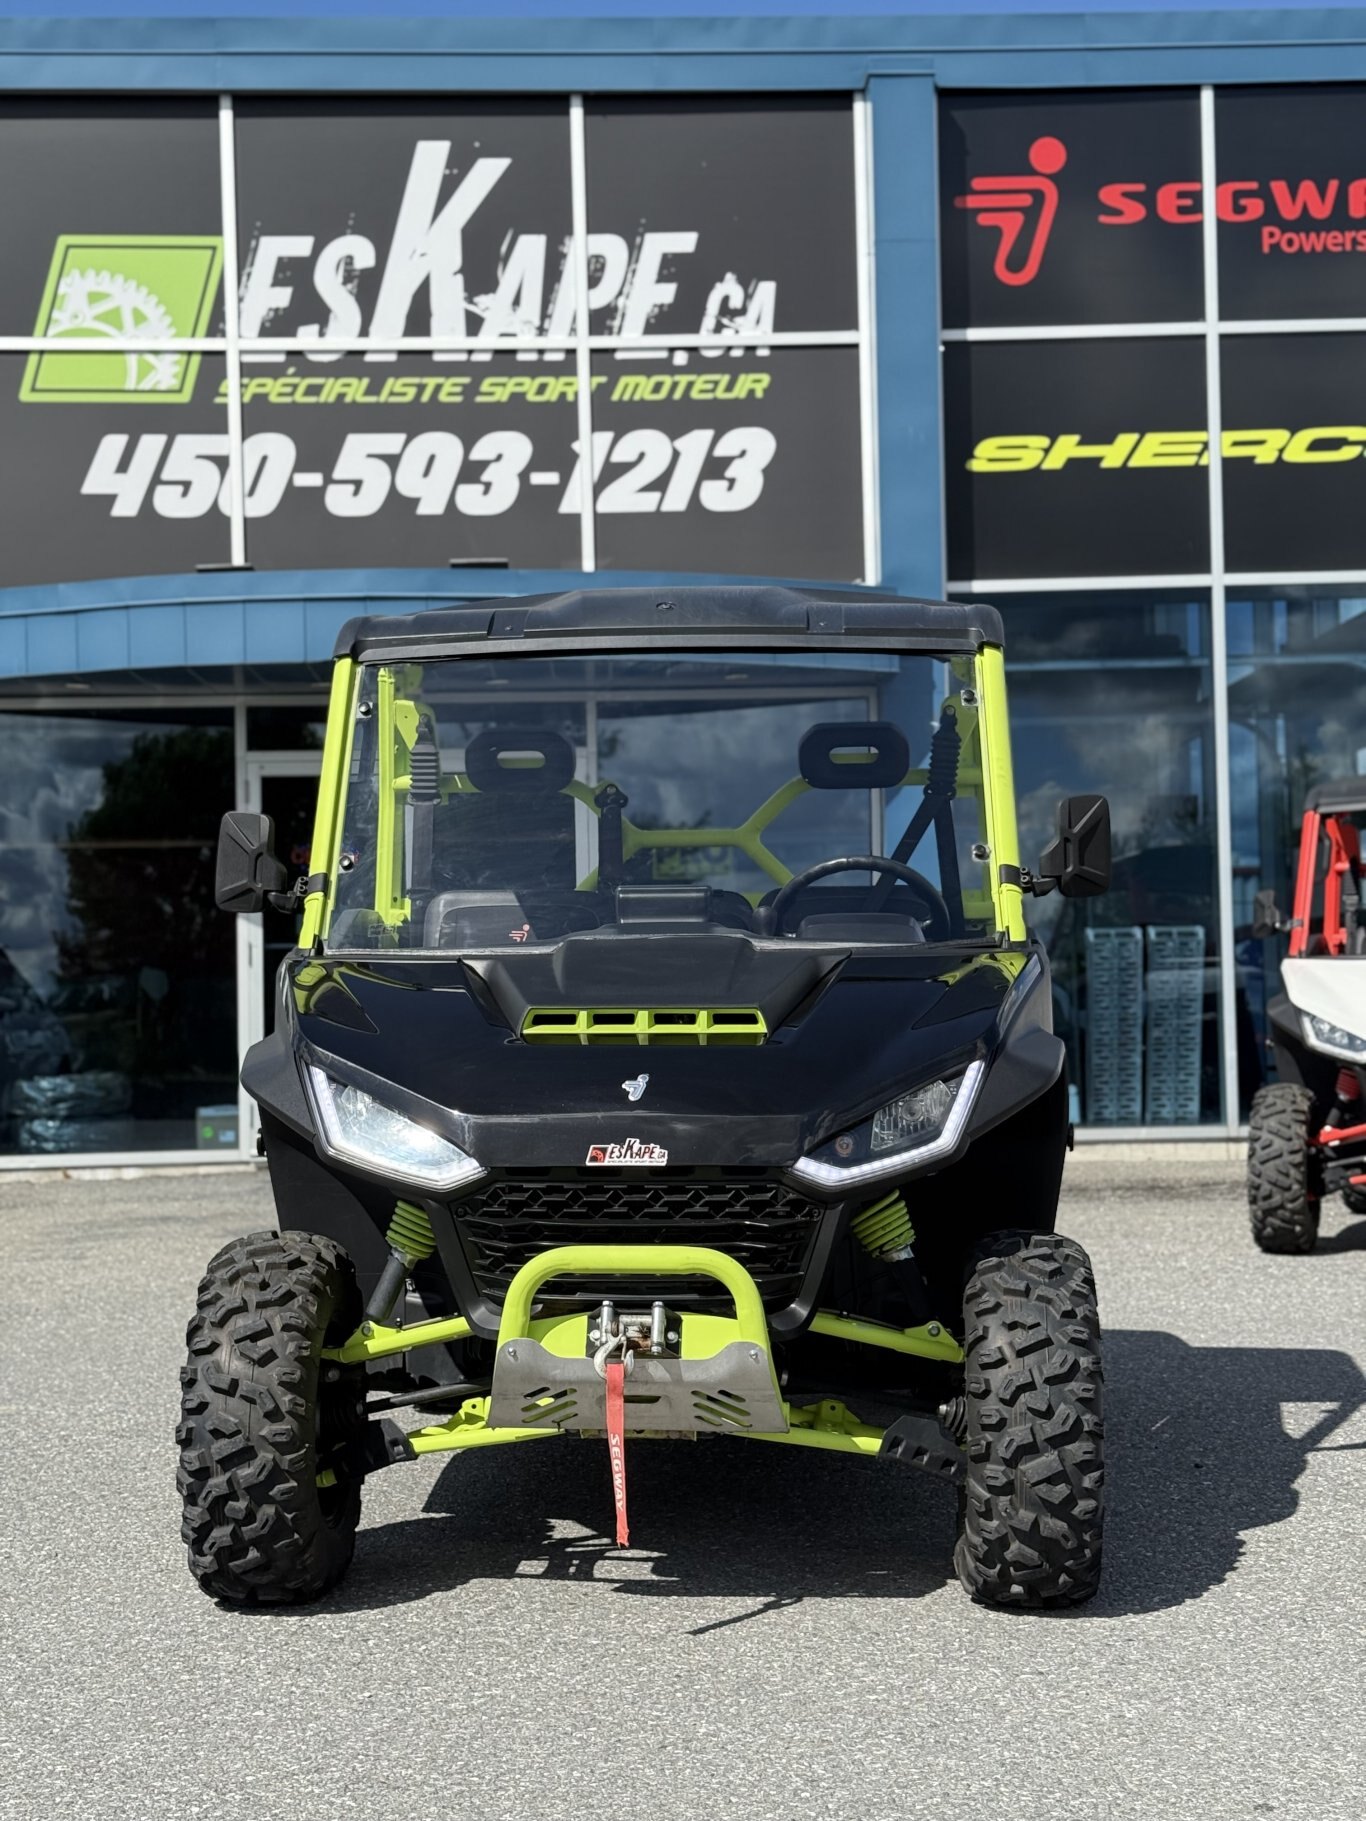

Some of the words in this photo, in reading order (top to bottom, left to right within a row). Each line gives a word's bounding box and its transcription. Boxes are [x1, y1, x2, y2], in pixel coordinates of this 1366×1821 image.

[611, 373, 770, 401] MOTEUR
[80, 427, 777, 518] 450-593-1213
[610, 1433, 623, 1511] SEGWAY
